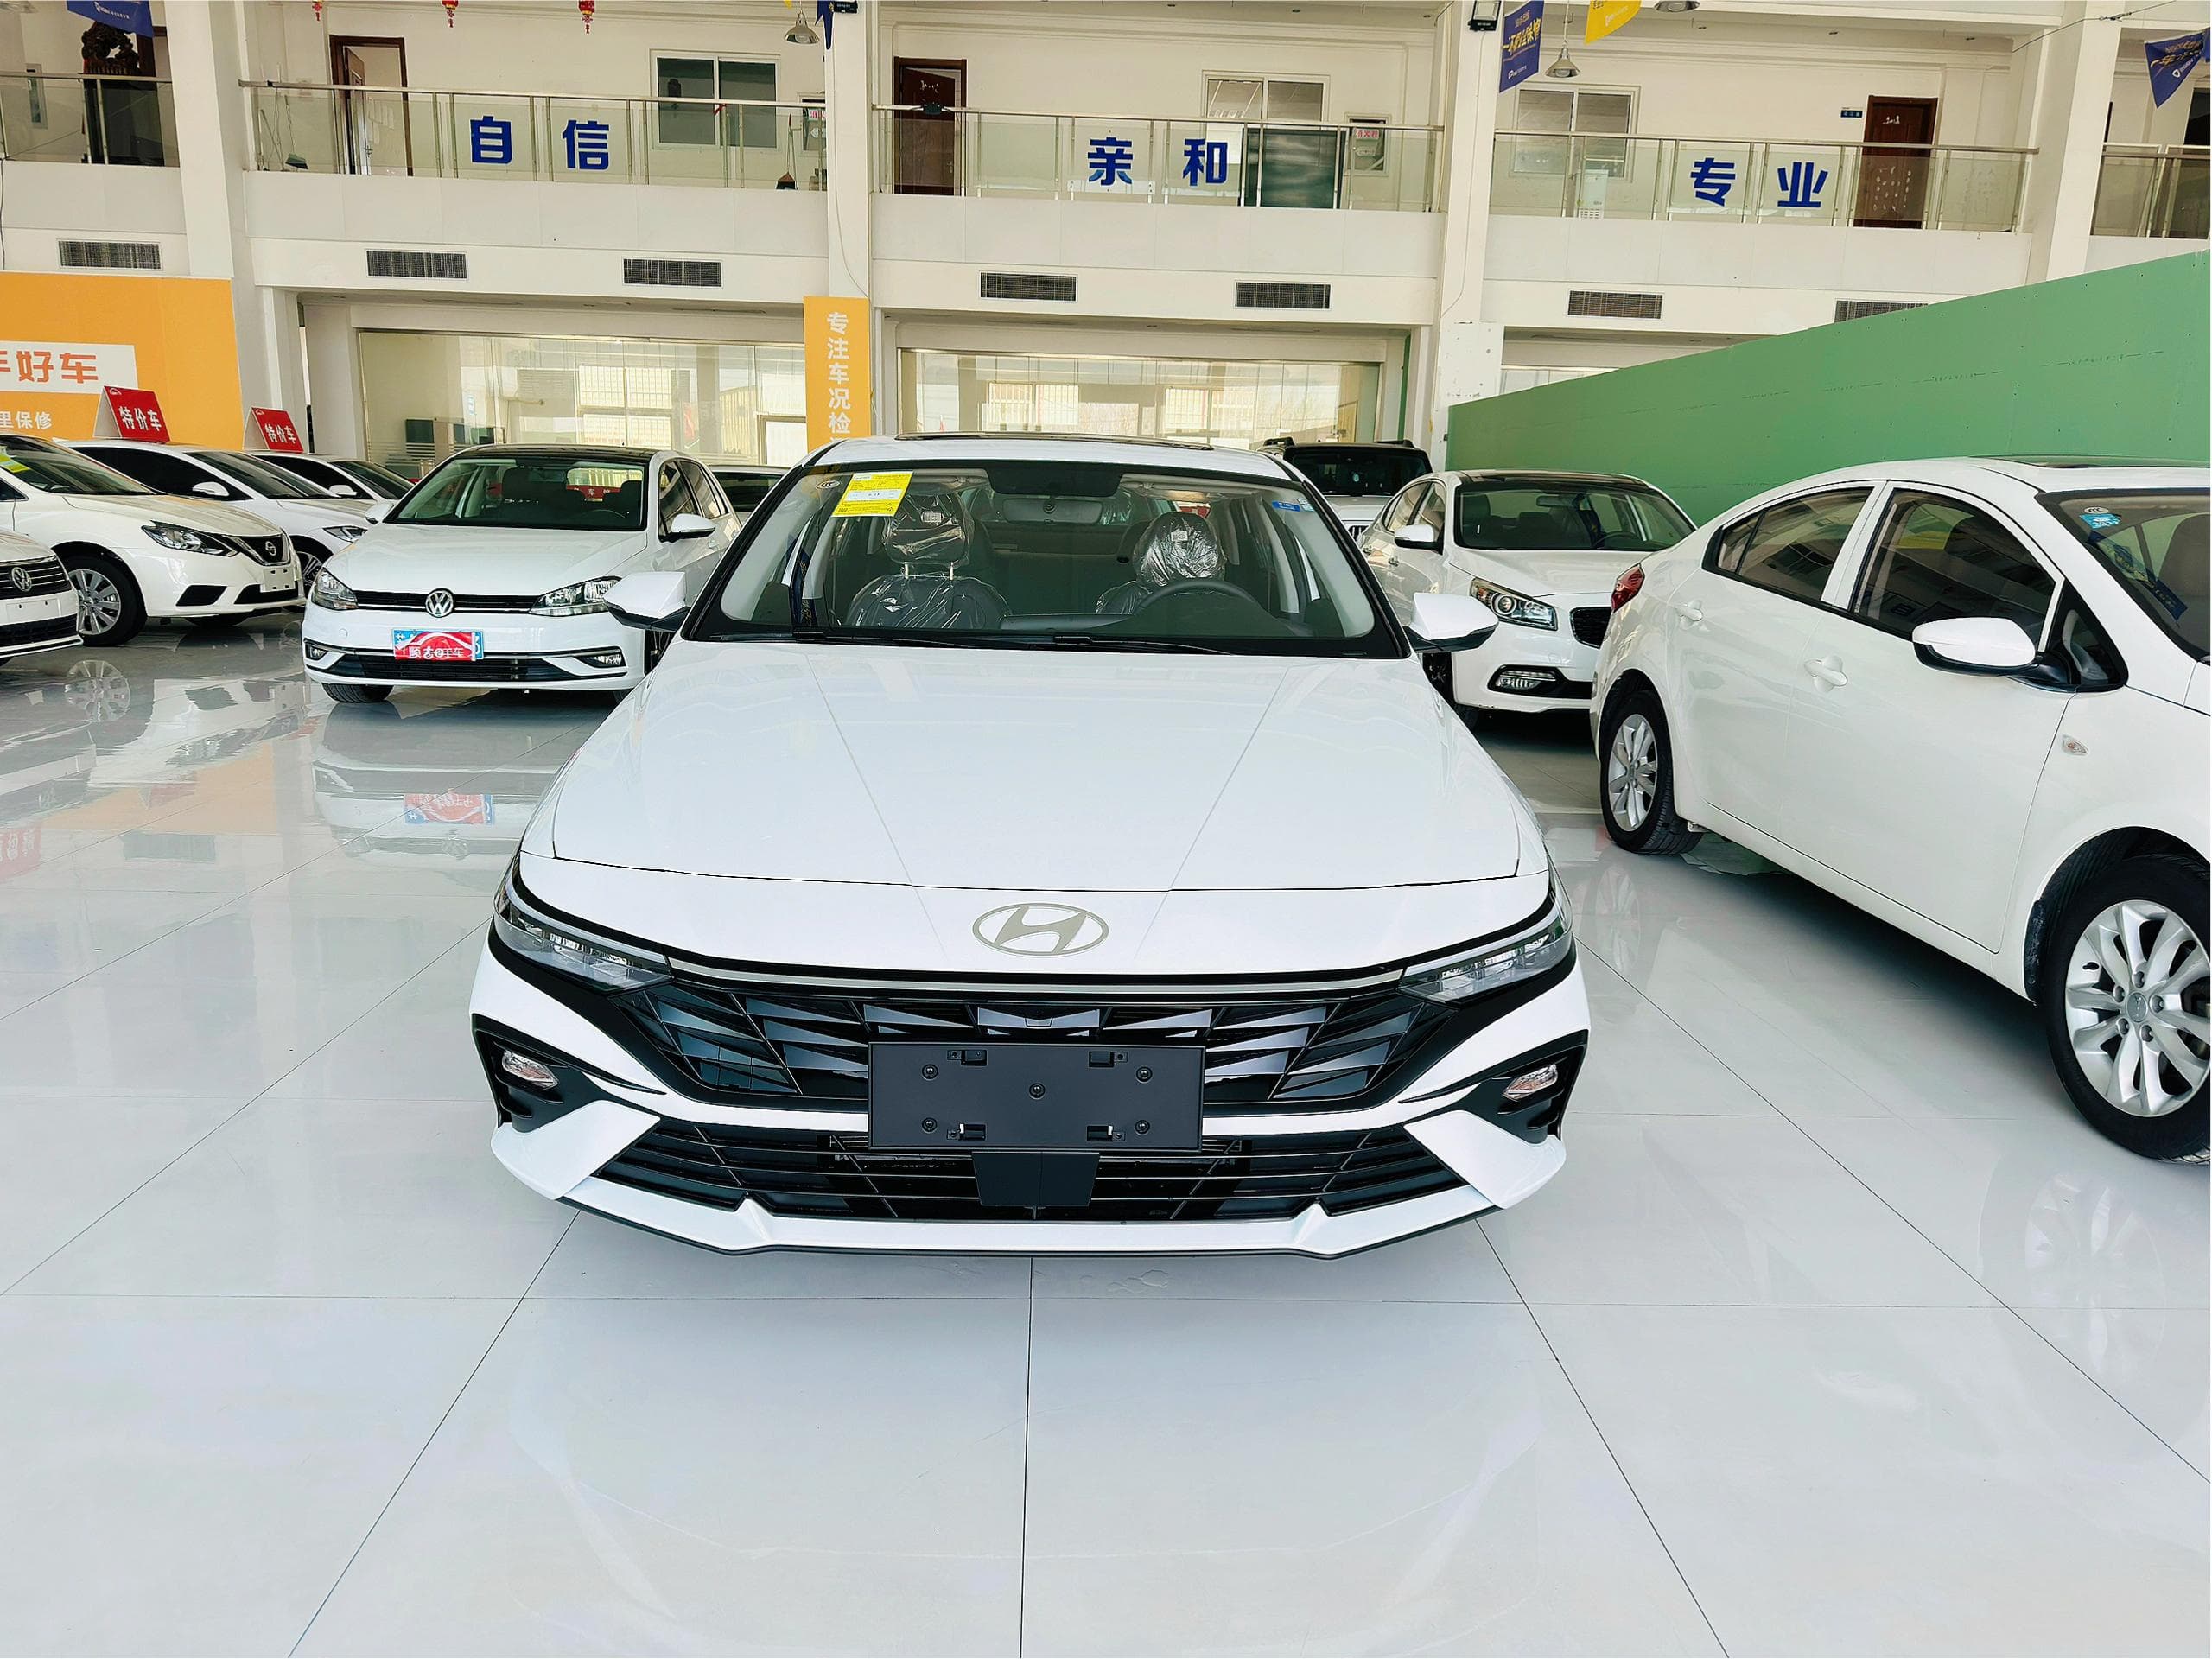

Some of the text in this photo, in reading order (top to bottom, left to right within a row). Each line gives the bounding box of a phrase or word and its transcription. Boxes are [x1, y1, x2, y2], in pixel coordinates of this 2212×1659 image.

[469, 116, 610, 170] 自信
[1087, 137, 1229, 187] 亲和
[1690, 157, 1829, 207] 专业
[826, 312, 851, 442] 专注车况检
[0, 410, 52, 429] 里保修
[118, 406, 162, 431] 特价车
[264, 423, 296, 444] 特价车
